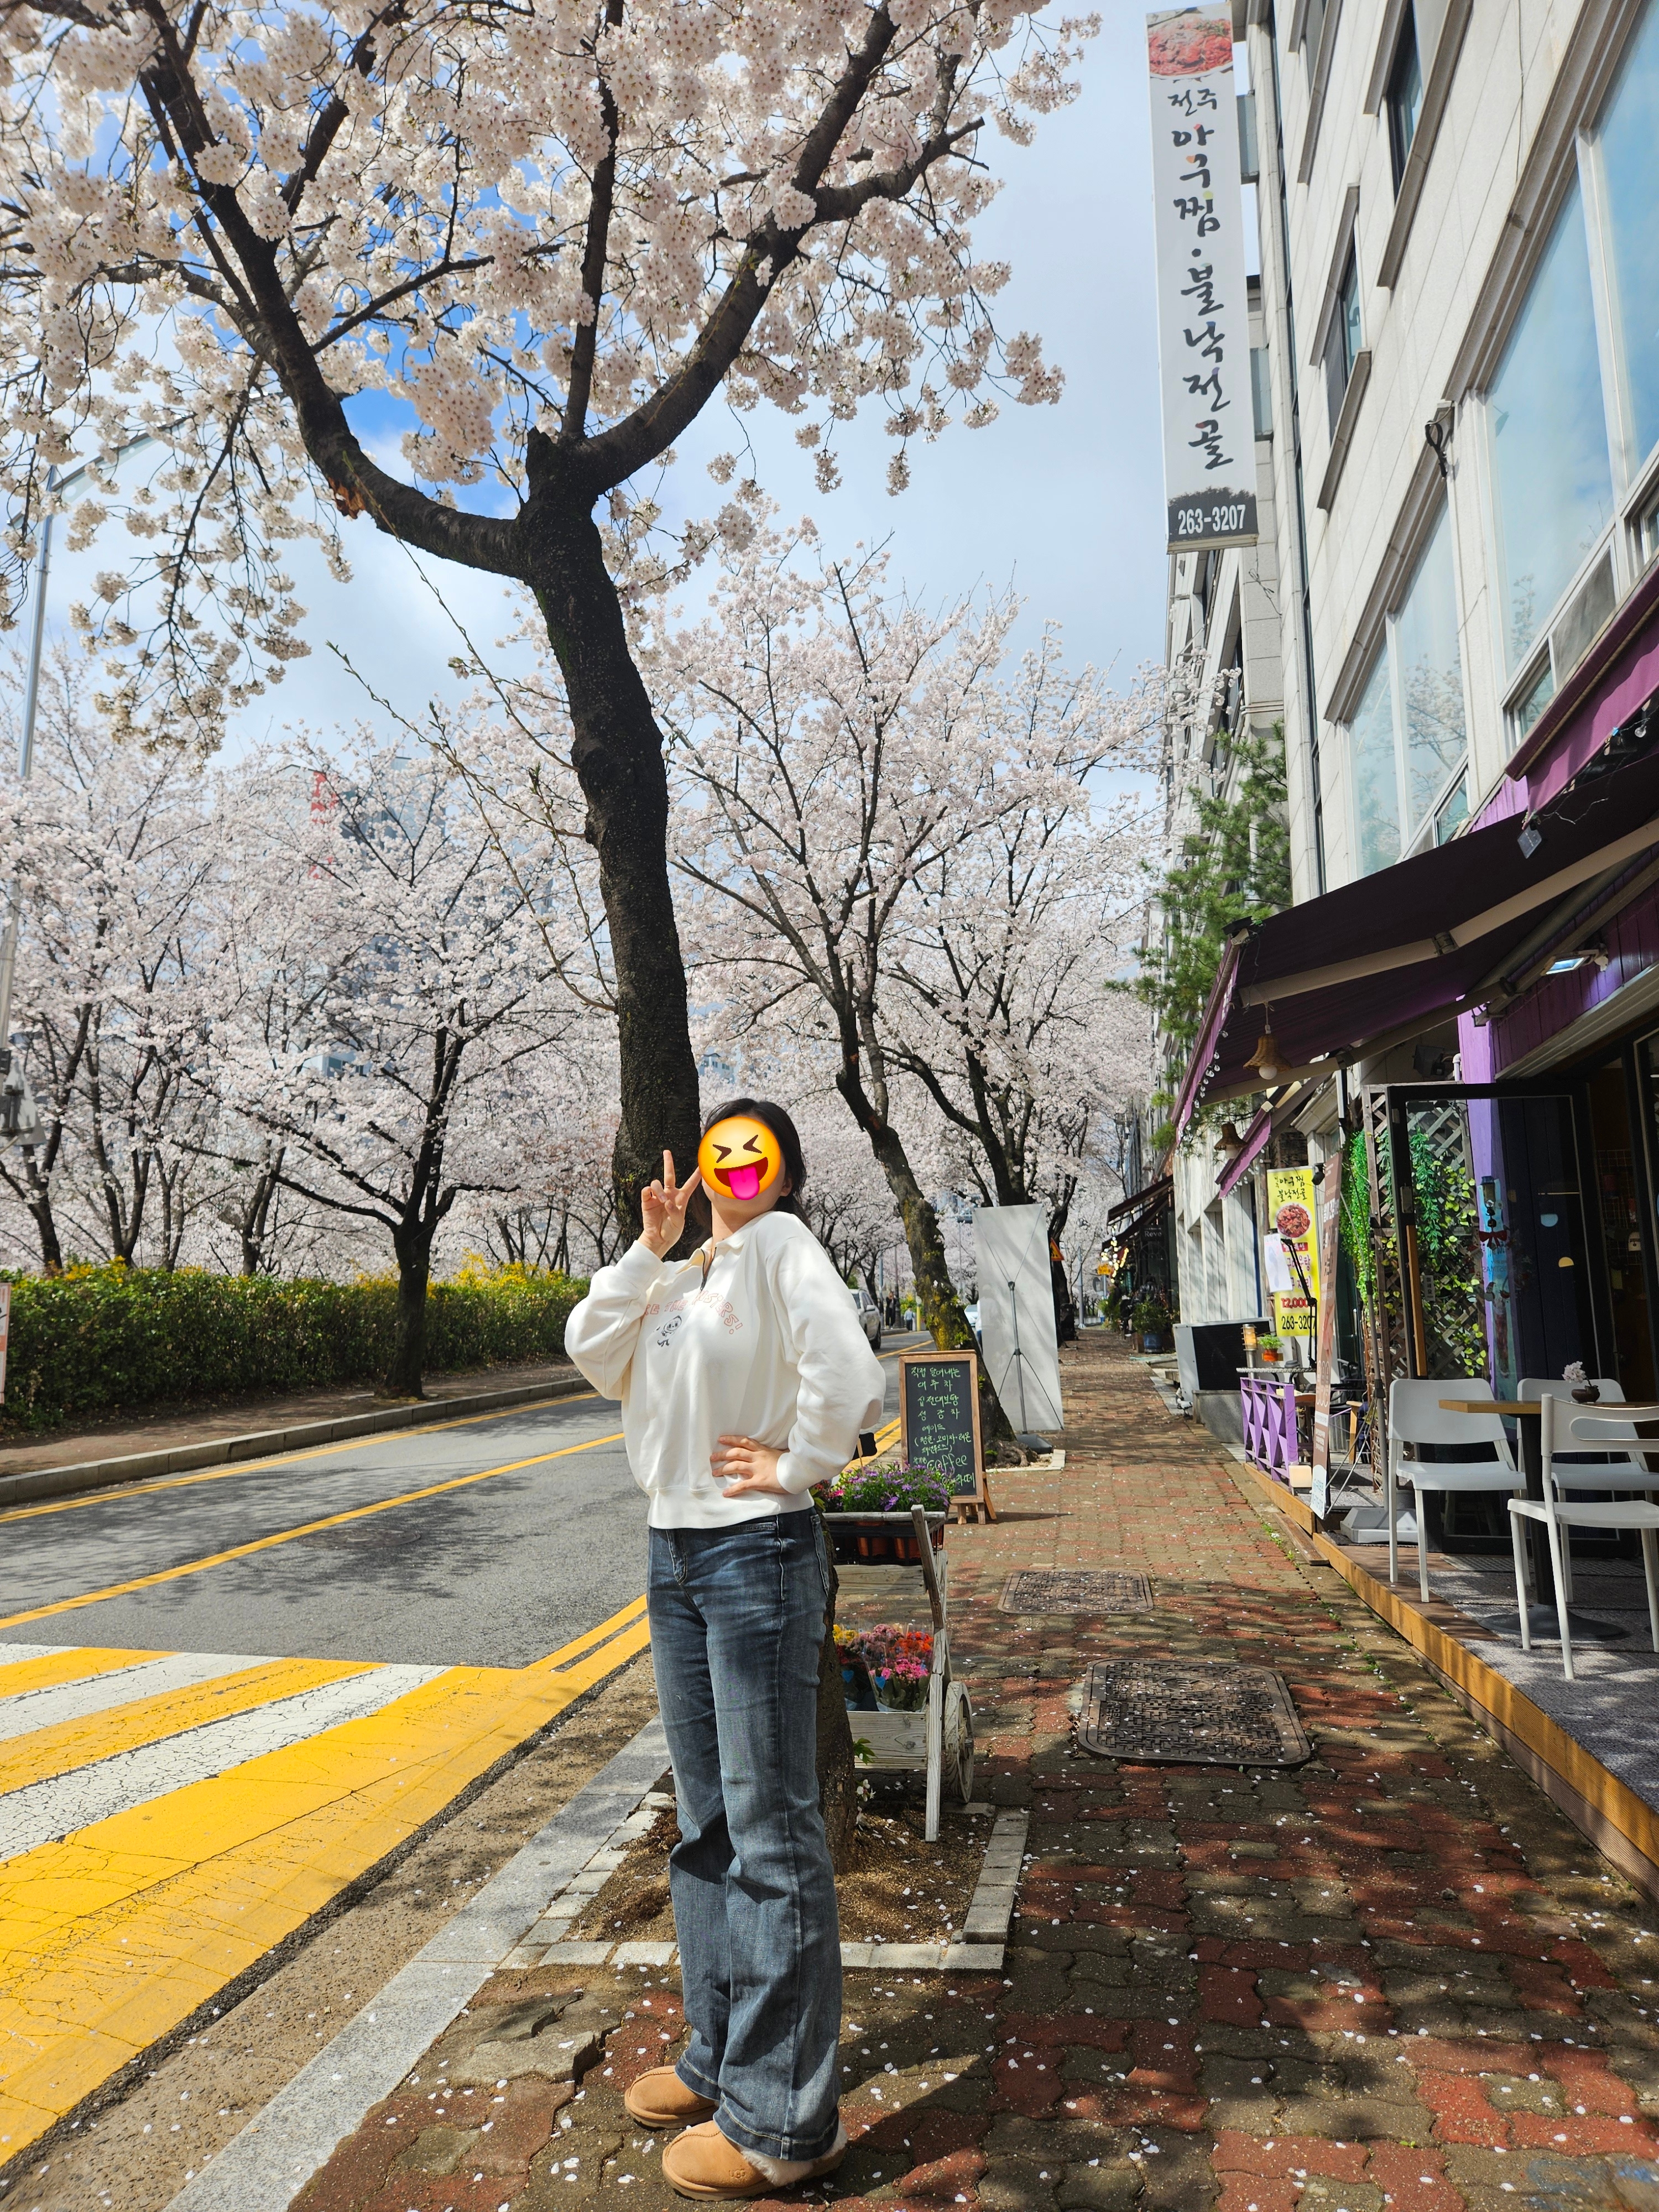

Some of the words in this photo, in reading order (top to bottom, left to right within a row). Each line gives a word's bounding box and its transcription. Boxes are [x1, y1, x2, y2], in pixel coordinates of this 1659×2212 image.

[1167, 88, 1217, 117] 전주
[1178, 504, 1246, 535] 263-3207
[1279, 1175, 1305, 1187] 아구찜
[1277, 1188, 1307, 1202] 불낙전골
[664, 1300, 688, 1312] THE
[911, 1366, 926, 1378] 직접
[922, 1423, 946, 1434] 에이드
[728, 2168, 745, 2178] UGG
